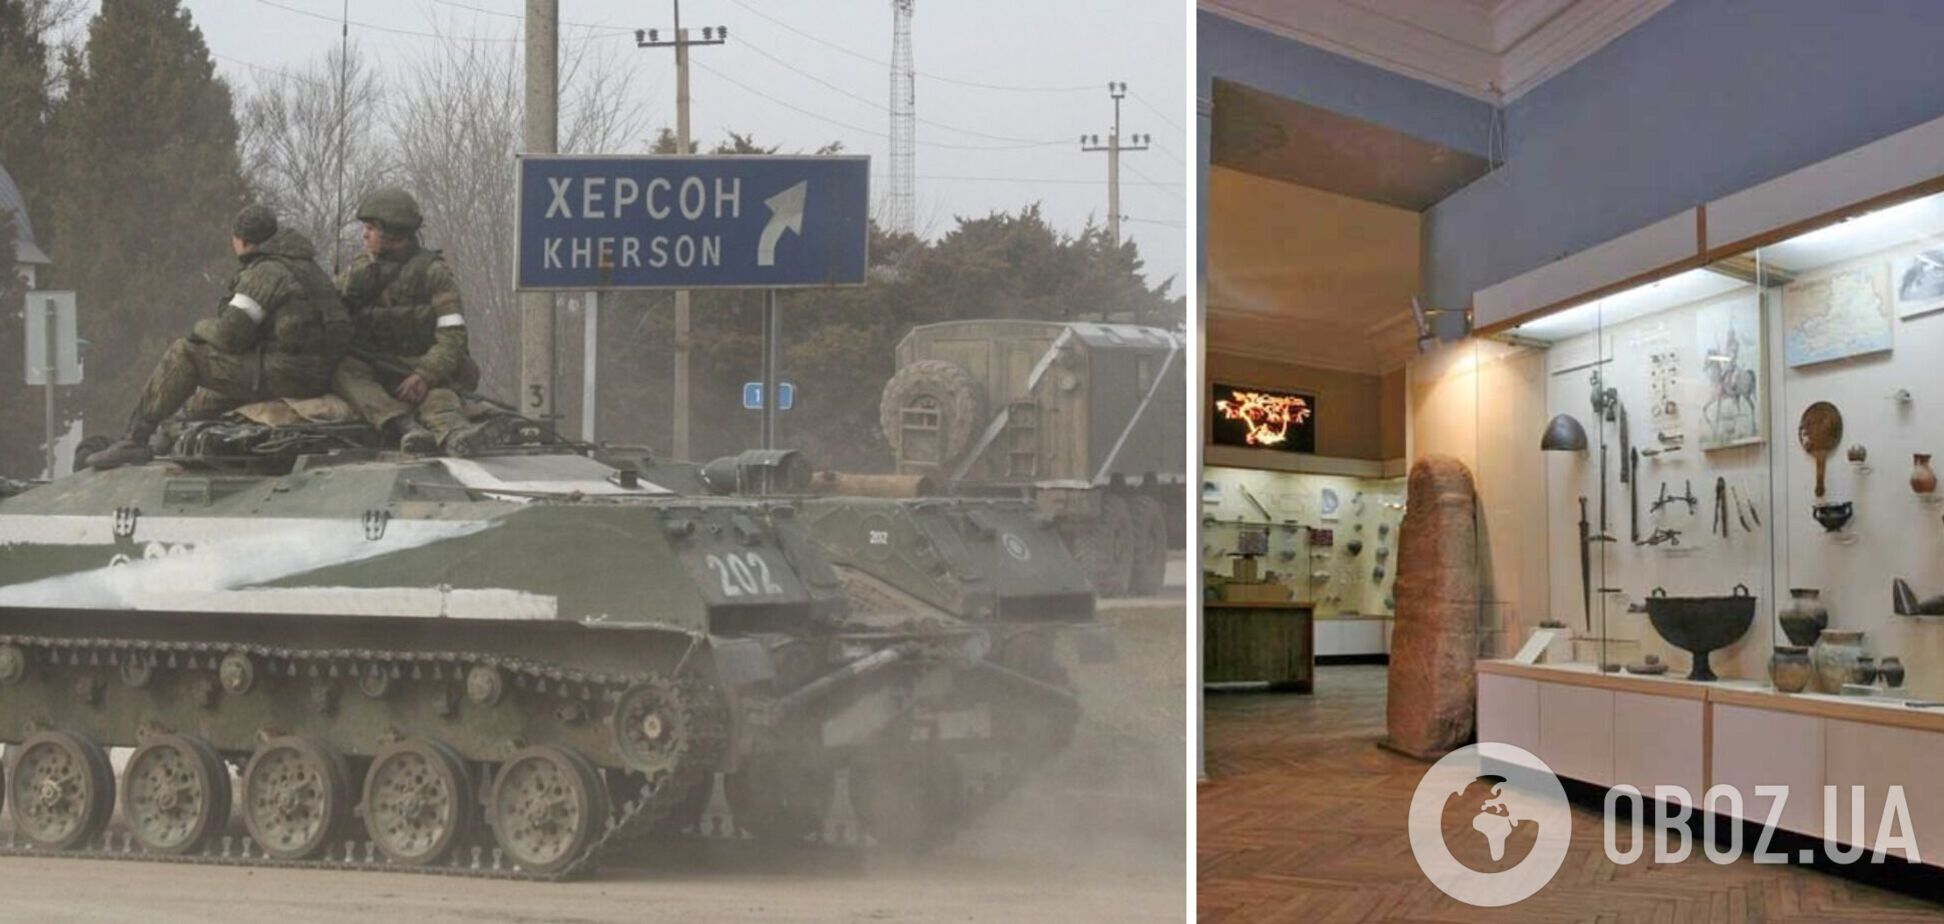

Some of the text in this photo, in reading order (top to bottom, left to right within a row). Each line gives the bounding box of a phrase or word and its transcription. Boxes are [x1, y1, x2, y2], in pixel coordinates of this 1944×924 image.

[544, 176, 741, 220] ХЕРСОН
[543, 235, 721, 269] KHERSON
[529, 384, 543, 408] 3
[869, 530, 888, 544] 202
[705, 552, 784, 596] 202
